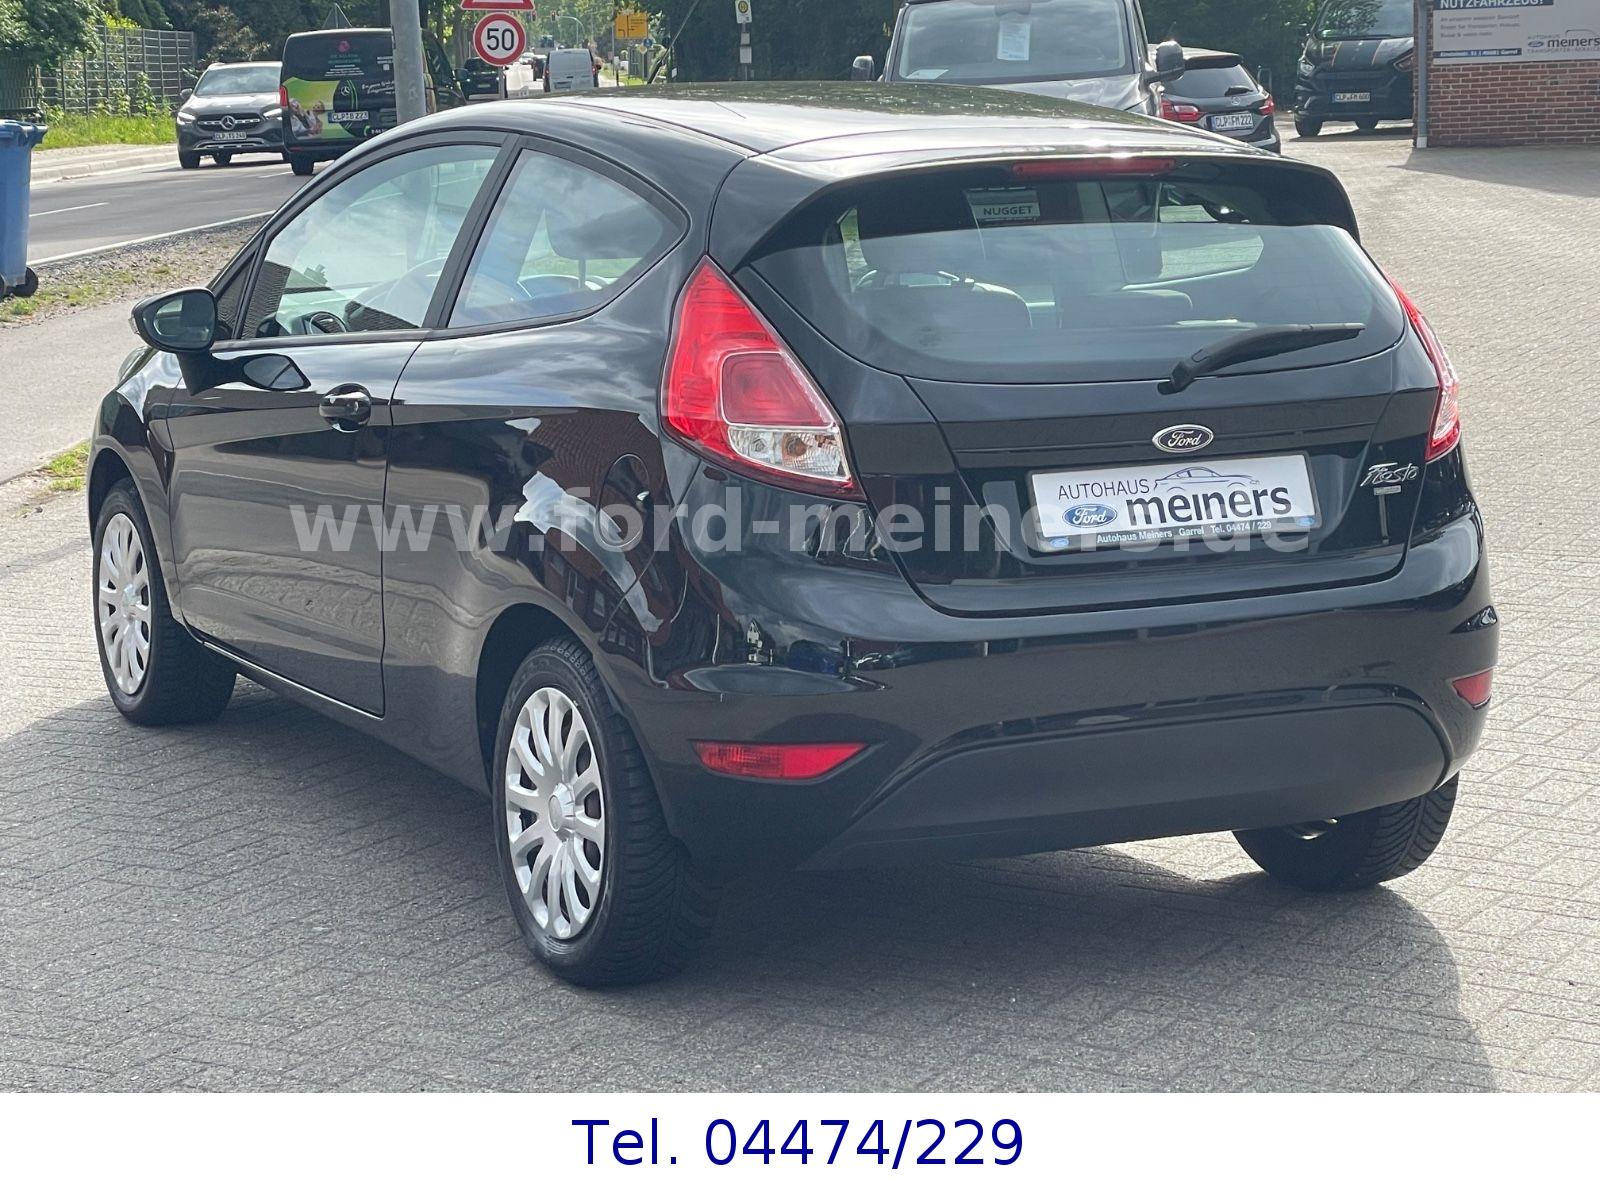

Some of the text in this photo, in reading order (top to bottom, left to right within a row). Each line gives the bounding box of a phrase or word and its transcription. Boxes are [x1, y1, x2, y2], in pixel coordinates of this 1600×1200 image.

[487, 28, 514, 51] 50
[1547, 38, 1600, 47] meiners
[983, 205, 1033, 216] NUGGET
[1167, 430, 1203, 447] Ford
[1360, 463, 1419, 486] Fiesta
[1058, 478, 1150, 500] AUTOHAUS
[1126, 486, 1291, 526] meiners
[1096, 532, 1137, 544] Autohaus
[1138, 529, 1173, 541] Meiners
[1178, 526, 1205, 537] Garrel
[1210, 524, 1225, 534] Tel.
[1226, 522, 1250, 532] 04474
[1257, 520, 1272, 530] 229
